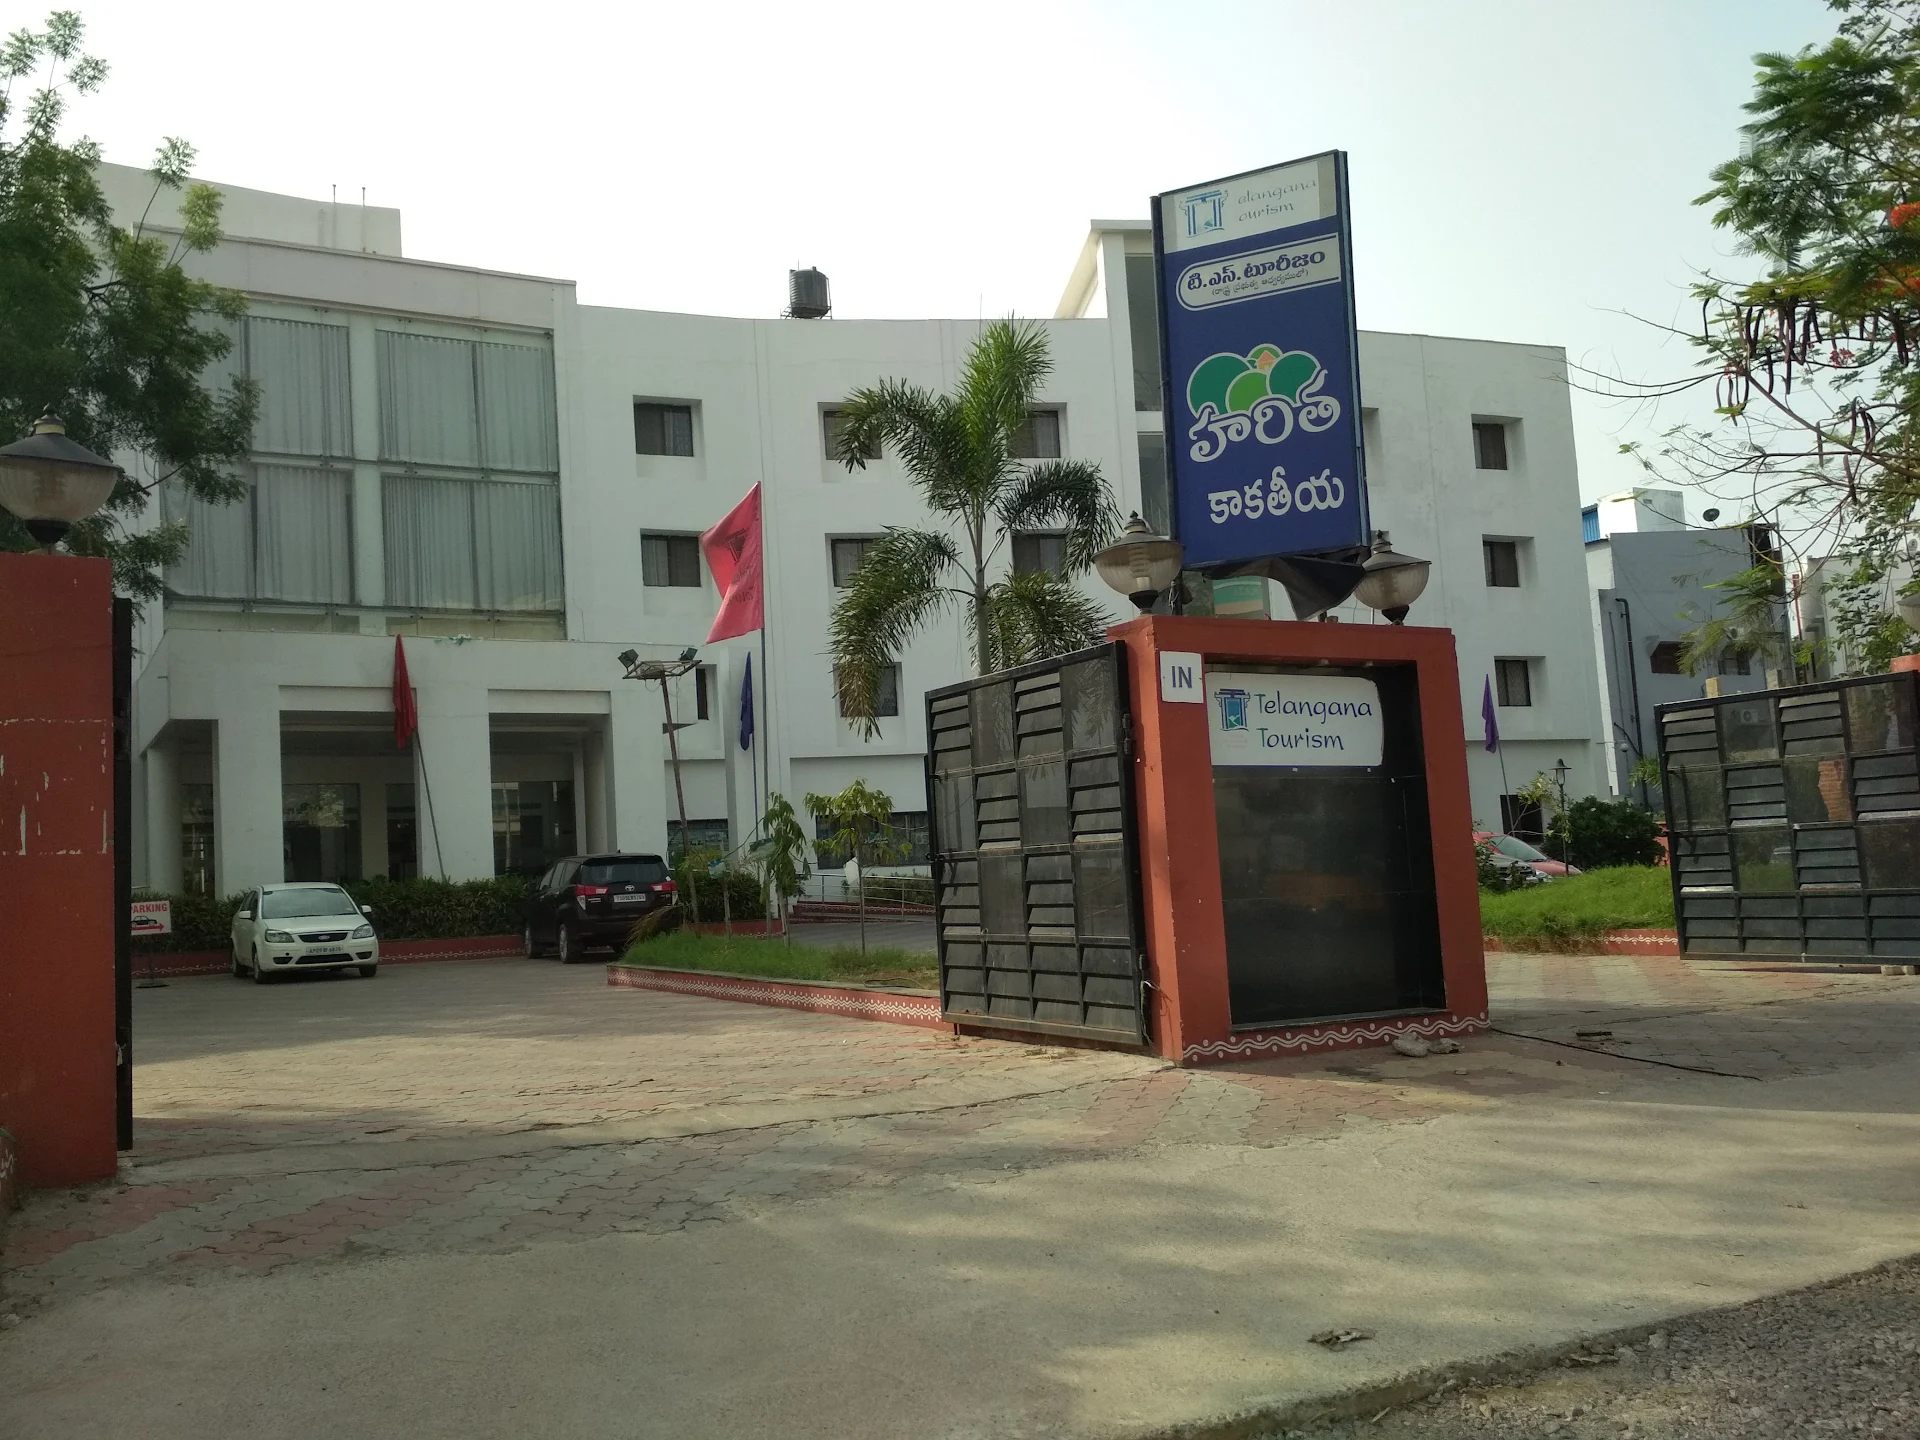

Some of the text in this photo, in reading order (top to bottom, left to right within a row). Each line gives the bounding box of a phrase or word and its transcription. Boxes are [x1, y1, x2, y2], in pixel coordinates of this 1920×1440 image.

[1208, 466, 1344, 524] కాకతీయ
[1171, 666, 1192, 689] IN
[1254, 690, 1372, 725] Telangana
[1256, 727, 1344, 751] Tourism
[131, 903, 168, 914] ARKING
